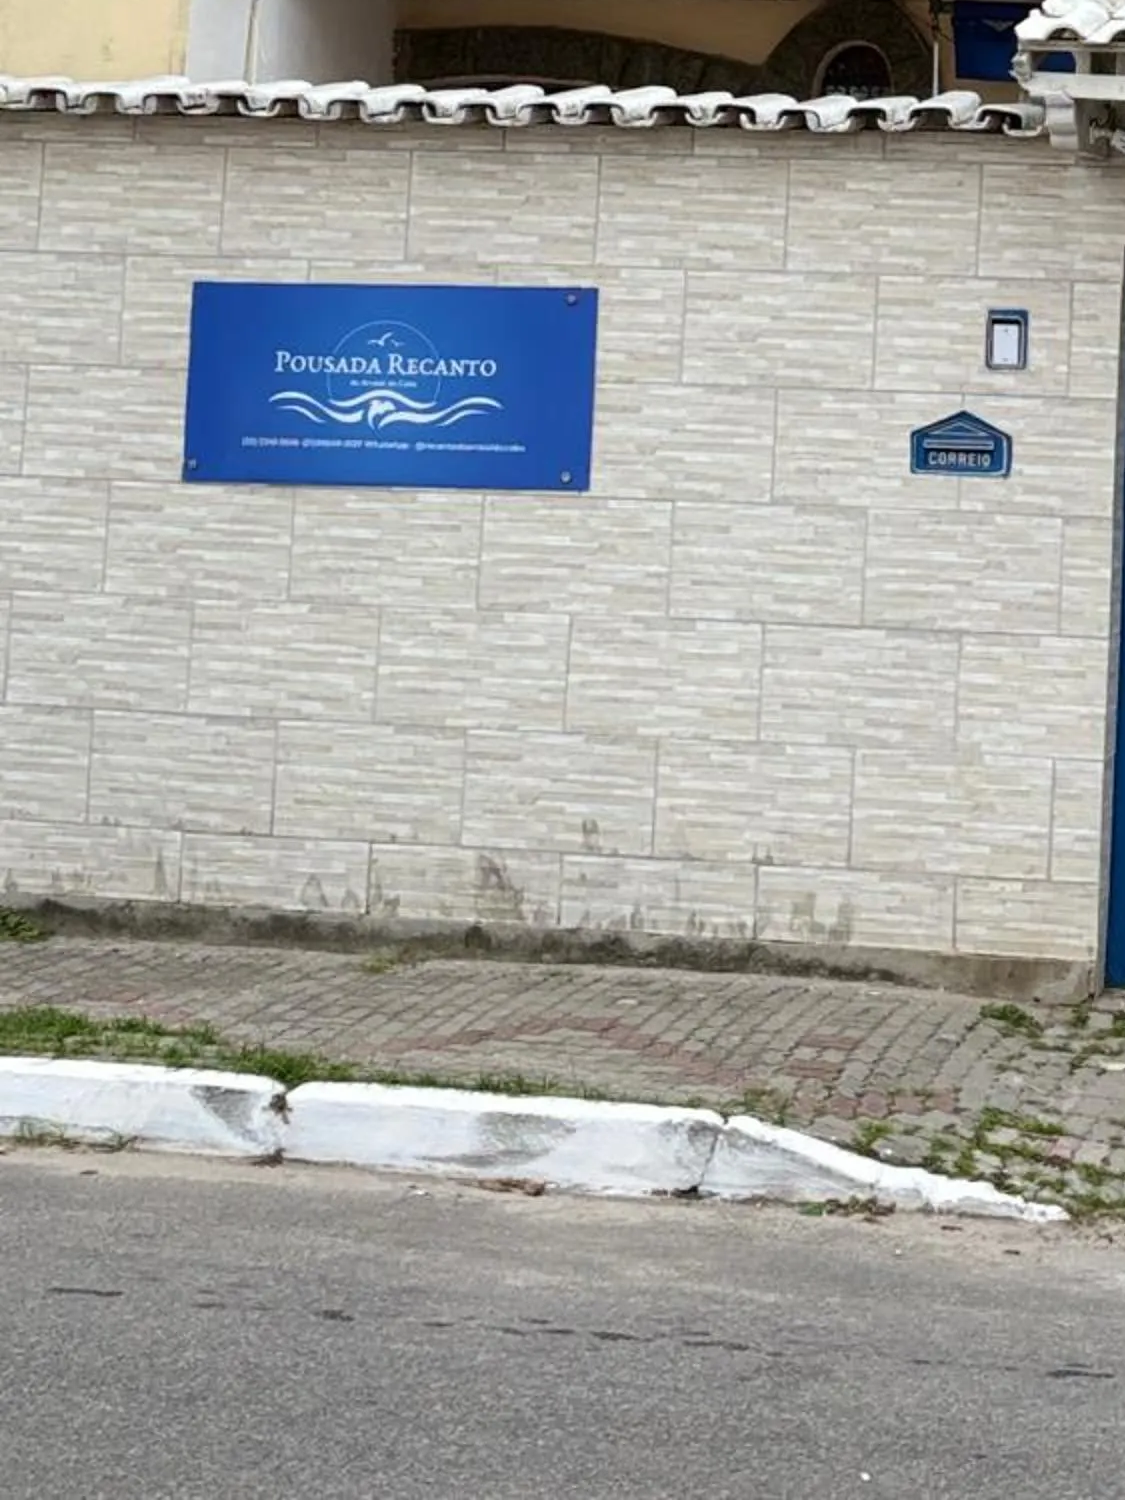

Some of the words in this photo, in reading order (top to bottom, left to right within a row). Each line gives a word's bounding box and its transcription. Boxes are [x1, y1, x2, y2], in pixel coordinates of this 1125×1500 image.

[274, 350, 381, 374] POUSADA
[388, 353, 497, 377] RECANTO
[927, 451, 991, 467] CORREIO
